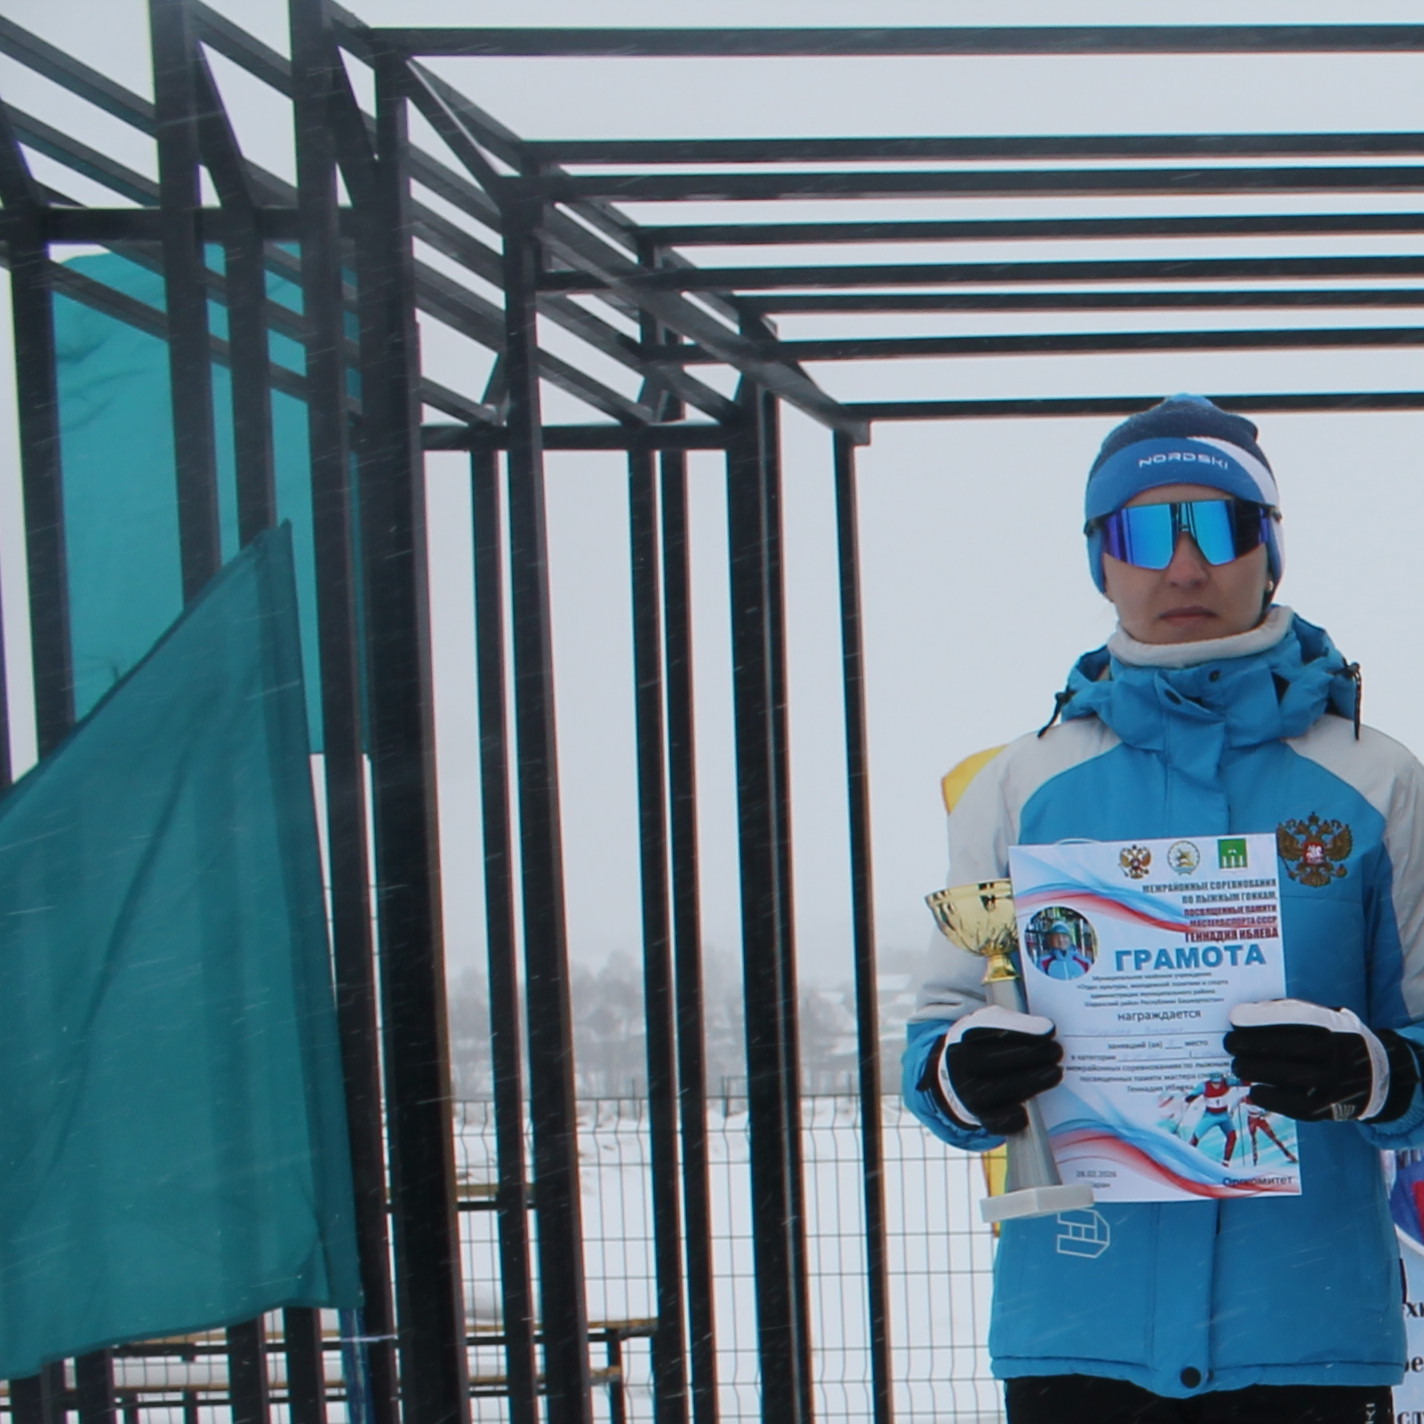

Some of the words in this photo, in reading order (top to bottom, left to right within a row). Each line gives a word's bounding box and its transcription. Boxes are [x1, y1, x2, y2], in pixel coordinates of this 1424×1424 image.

[1138, 452, 1229, 470] NORDSKI
[1115, 944, 1266, 972] ГРАМОТА
[1117, 1009, 1201, 1022] награждается
[1222, 1175, 1293, 1187] Оргкомитет
